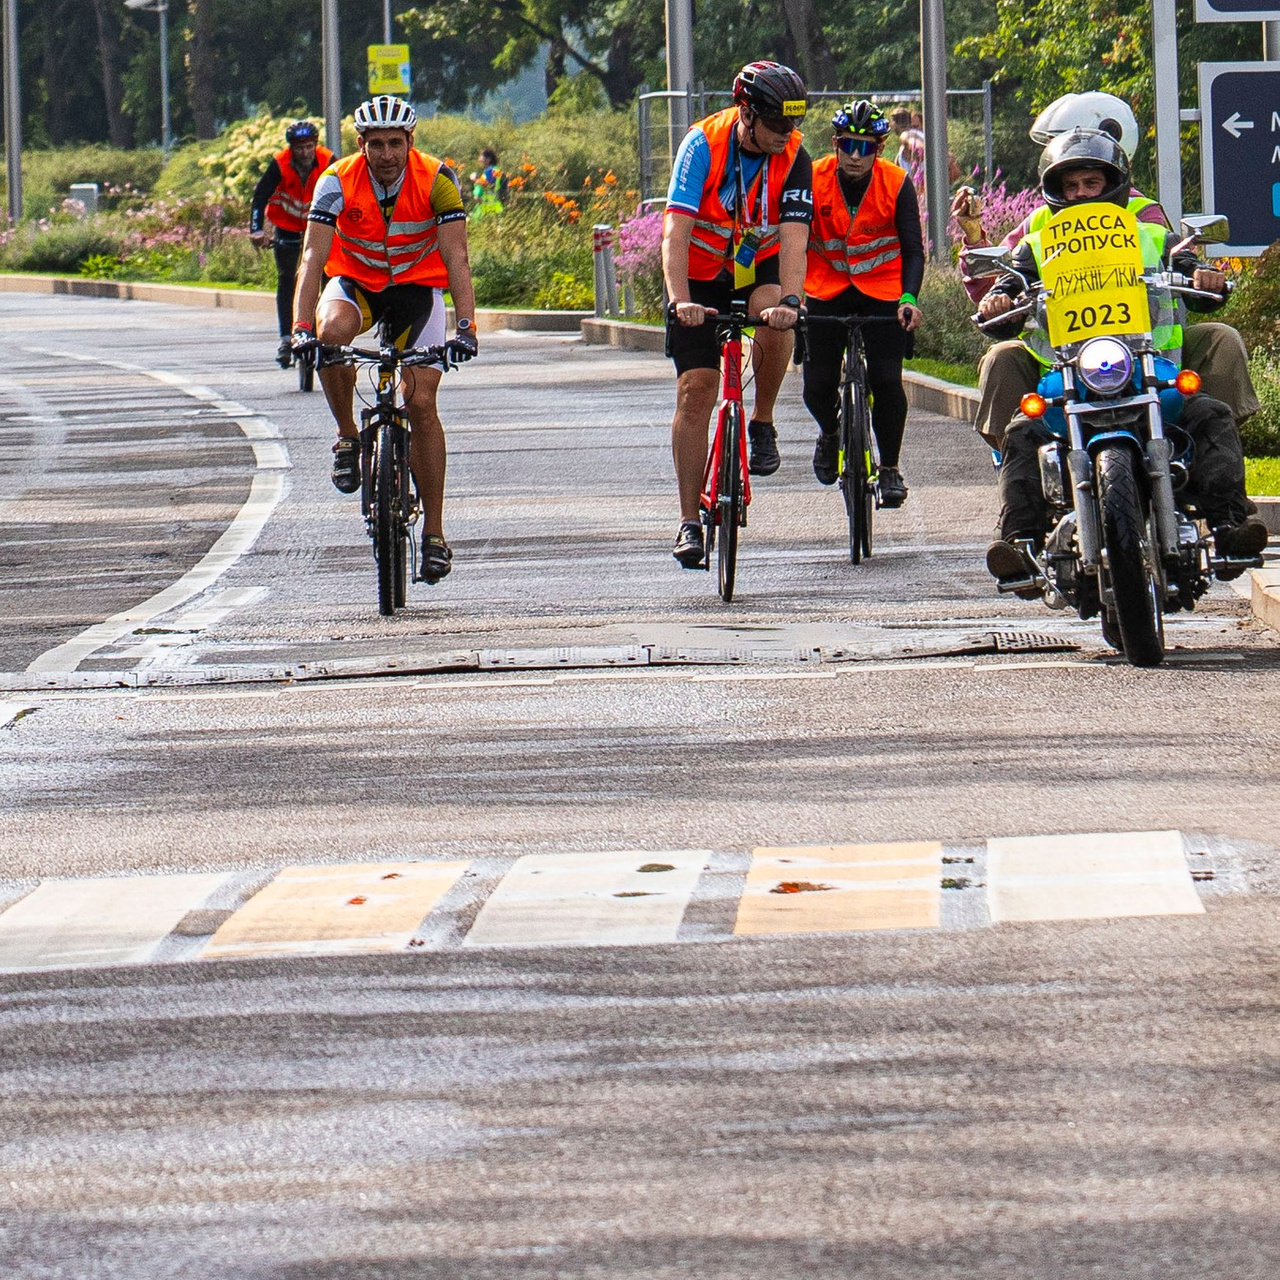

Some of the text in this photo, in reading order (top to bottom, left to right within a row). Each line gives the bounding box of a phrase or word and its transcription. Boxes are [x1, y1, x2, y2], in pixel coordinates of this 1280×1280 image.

[1049, 215, 1126, 240] ТРАССА
[1044, 233, 1137, 260] ПРОПУСК
[1052, 266, 1138, 299] ЛУЖНИКИ
[1064, 302, 1131, 333] 2023
